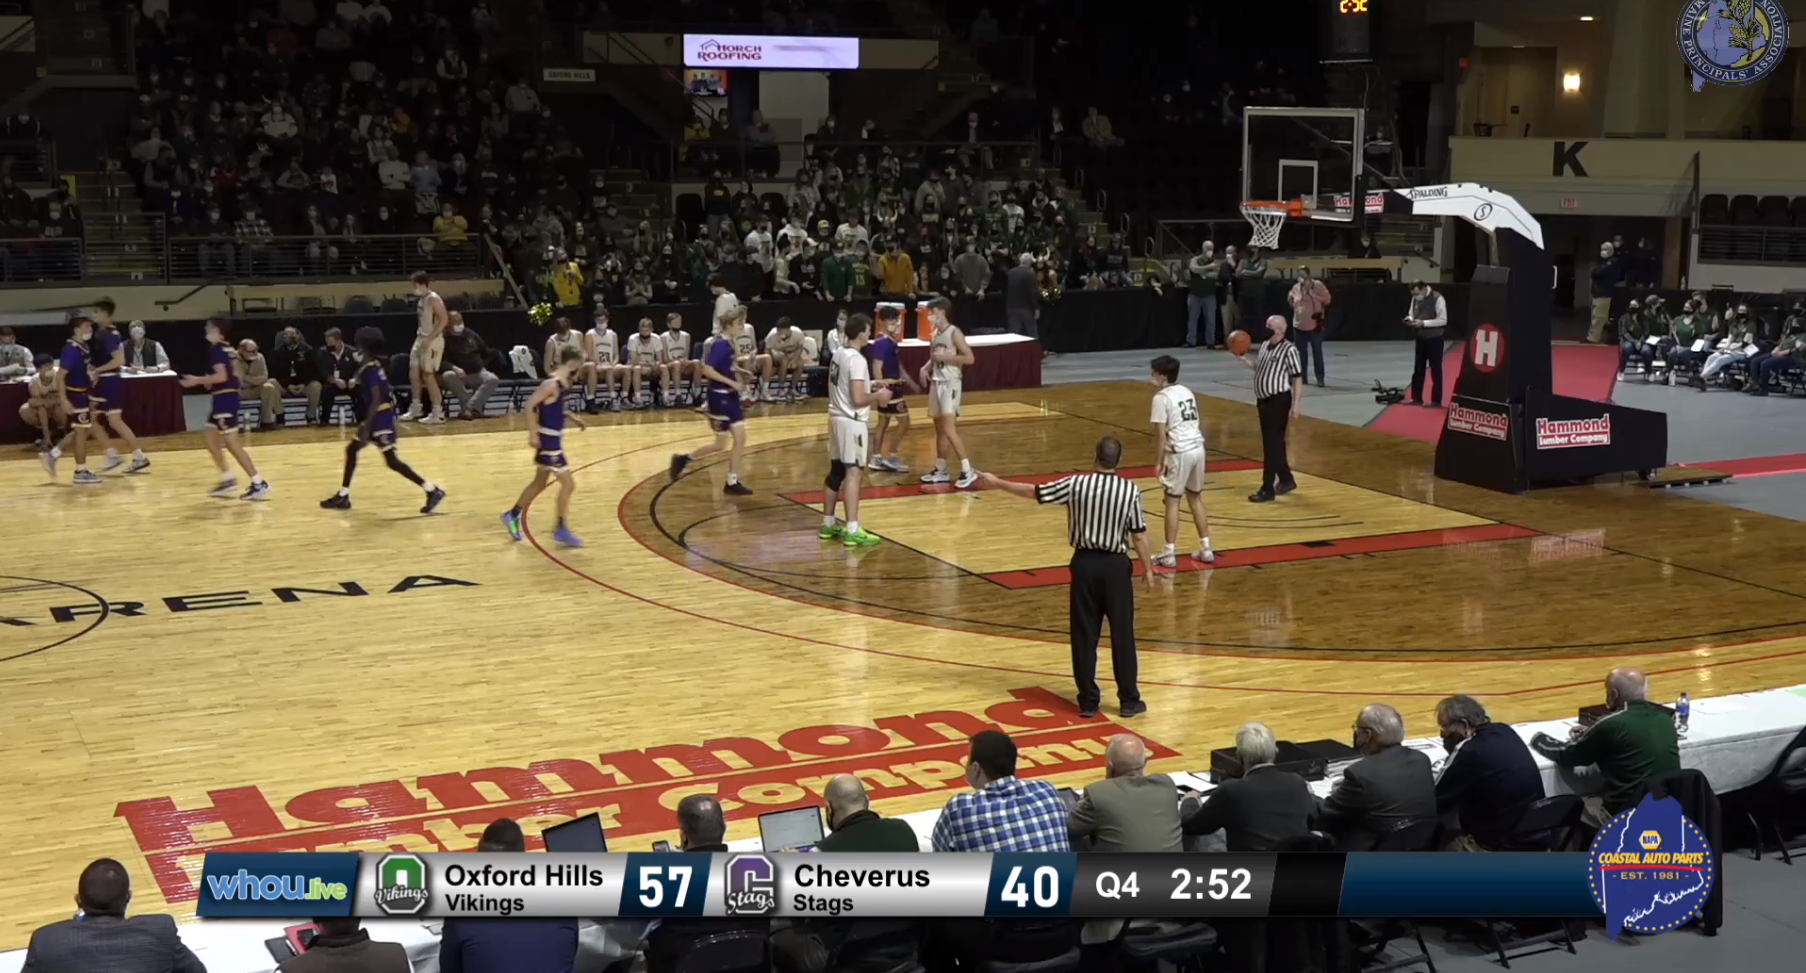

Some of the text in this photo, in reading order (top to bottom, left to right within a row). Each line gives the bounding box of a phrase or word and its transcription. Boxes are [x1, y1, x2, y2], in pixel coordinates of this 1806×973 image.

[697, 52, 762, 61] ROOFING
[1552, 141, 1590, 177] K
[1407, 187, 1448, 199] SPALDING
[1475, 329, 1498, 367] H
[1450, 404, 1508, 426] Hammond
[1450, 419, 1506, 438] Lumber Company
[1538, 416, 1609, 435] Hammond
[1539, 433, 1608, 446] Lumber Company
[113, 686, 1110, 850] Hammond
